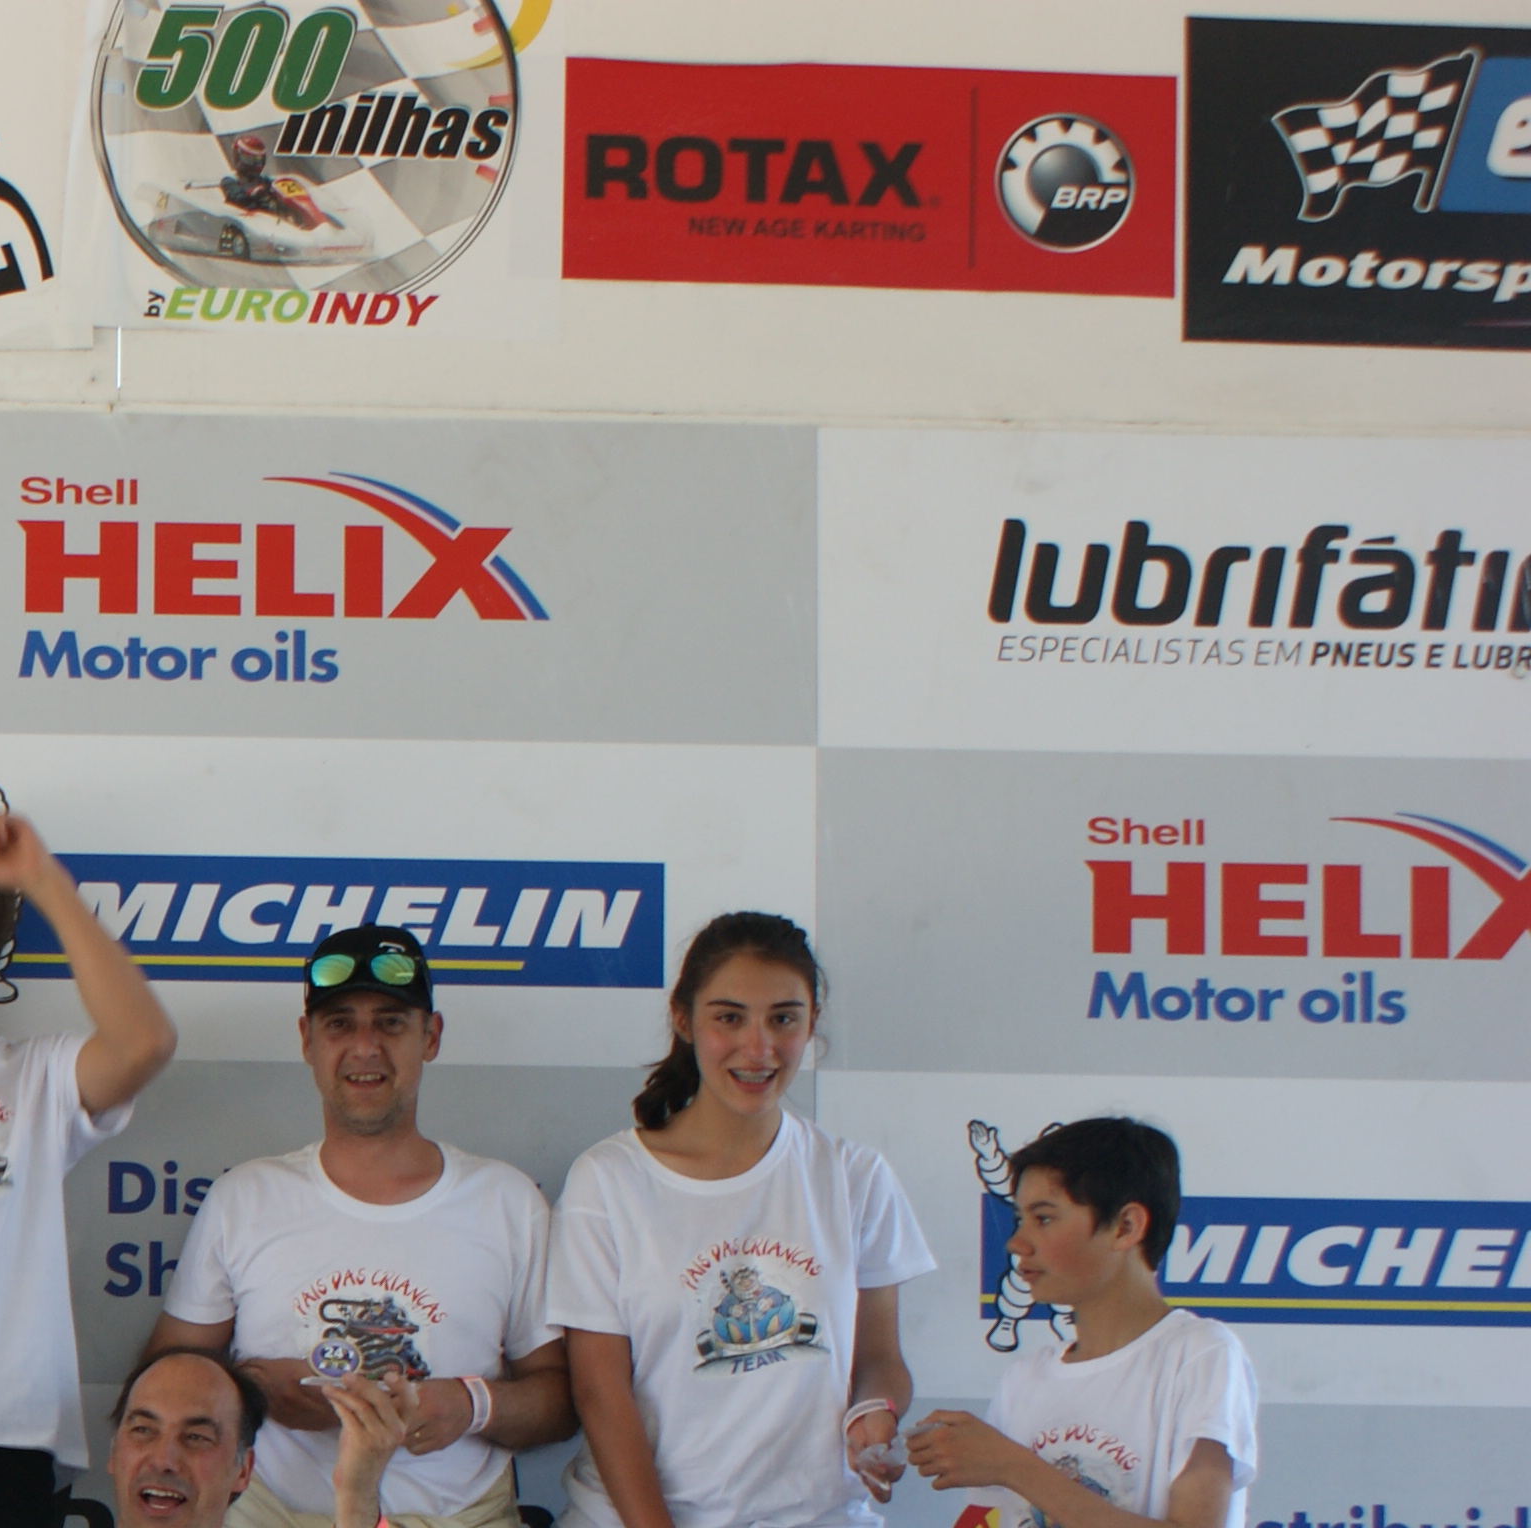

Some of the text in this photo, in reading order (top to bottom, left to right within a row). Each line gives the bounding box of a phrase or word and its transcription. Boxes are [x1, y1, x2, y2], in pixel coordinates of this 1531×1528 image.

[135, 4, 359, 111] 500
[274, 91, 510, 161] milhas
[583, 132, 925, 208] ROTAX
[1050, 185, 1128, 212] BRP
[688, 217, 926, 244] NEW AGE KARTING
[164, 286, 439, 327] EUROINDY
[19, 476, 138, 507] Shell
[17, 519, 534, 622] HELIX
[988, 518, 1531, 634] lubrifáti
[17, 630, 339, 684] Motor oils
[997, 636, 1245, 667] ESPECIALISTAS
[1253, 640, 1303, 667] EM
[1309, 641, 1416, 668] PNEUS
[1423, 643, 1447, 669] E
[1085, 816, 1206, 848] Shell
[77, 882, 642, 949] MICHELIN
[1086, 971, 1408, 1026] Motor oils
[1161, 1223, 1531, 1290] MICHE
[293, 1277, 328, 1315] PAIS
[330, 1267, 366, 1291] DAS
[730, 1350, 787, 1375] TEAM
